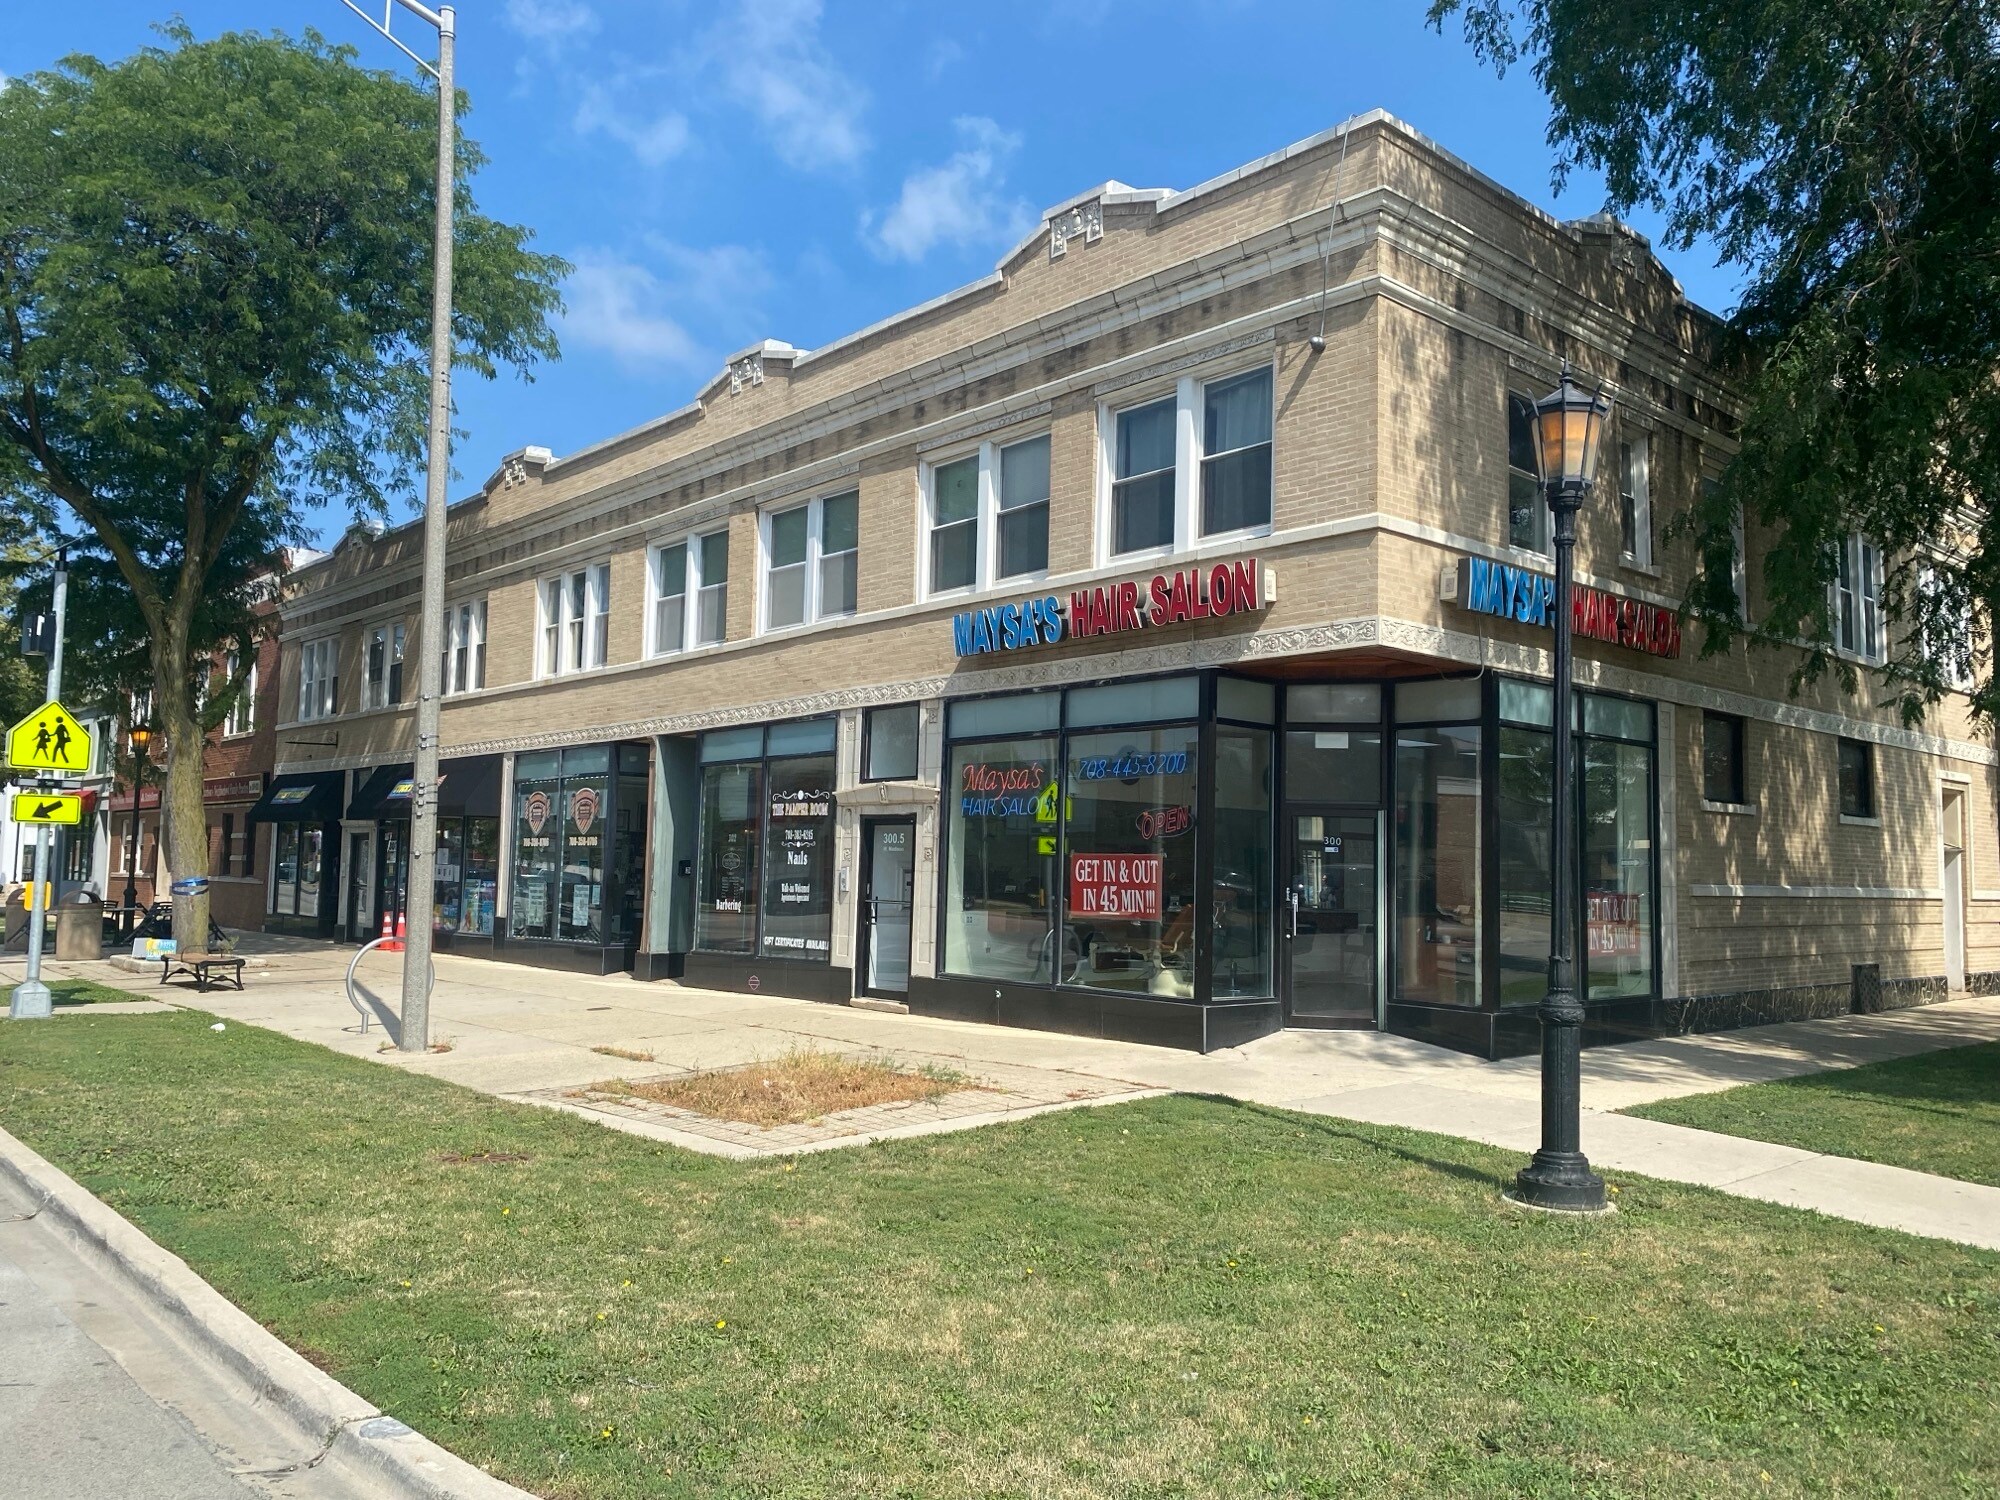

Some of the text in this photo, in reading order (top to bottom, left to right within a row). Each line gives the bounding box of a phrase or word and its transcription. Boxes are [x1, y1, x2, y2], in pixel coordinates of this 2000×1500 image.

[952, 557, 1260, 658] MAYSA'S HAIR SALON
[1468, 557, 1683, 659] MAYSA' HAIR SALON
[1078, 753, 1187, 780] 708-445-8200
[963, 762, 1044, 801] Maysa's
[961, 797, 997, 816] HAIR
[1141, 806, 1189, 840] OPEN
[883, 832, 905, 844] 300.5
[1324, 836, 1342, 846] 300
[787, 850, 808, 866] Nails
[1075, 859, 1159, 884] GET IN & OUT
[715, 899, 742, 913] Barbering
[1083, 888, 1097, 911] IN
[1100, 885, 1119, 912] 45
[1602, 897, 1611, 921] IN
[1613, 898, 1620, 921] &
[1621, 898, 1639, 921] OUT
[764, 935, 774, 946] GIFT
[1602, 924, 1614, 950] 45
